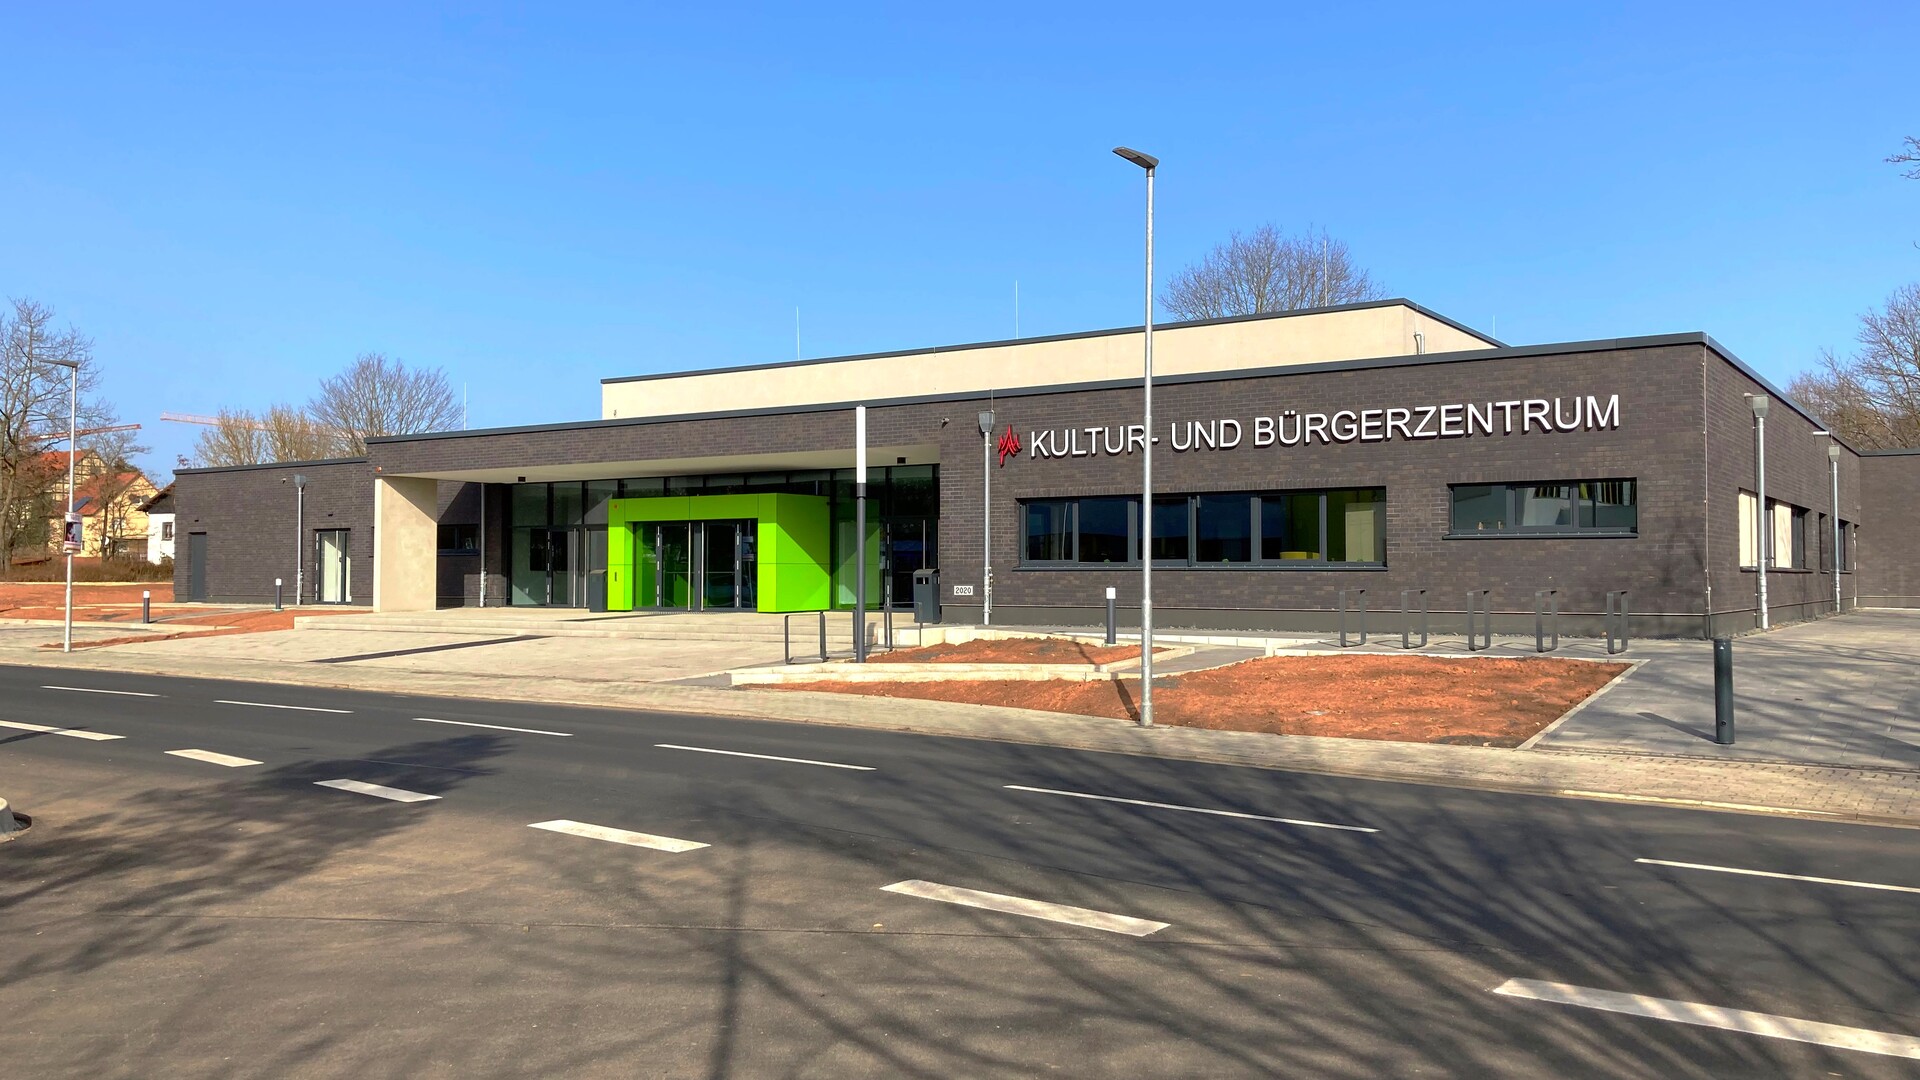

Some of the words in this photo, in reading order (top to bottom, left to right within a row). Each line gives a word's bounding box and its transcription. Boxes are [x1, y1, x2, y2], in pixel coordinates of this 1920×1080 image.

[1030, 425, 1159, 457] KULTUR-
[1171, 419, 1242, 451] UND
[1254, 394, 1620, 446] BÜRGERZENTRUM
[955, 586, 972, 595] 2020
